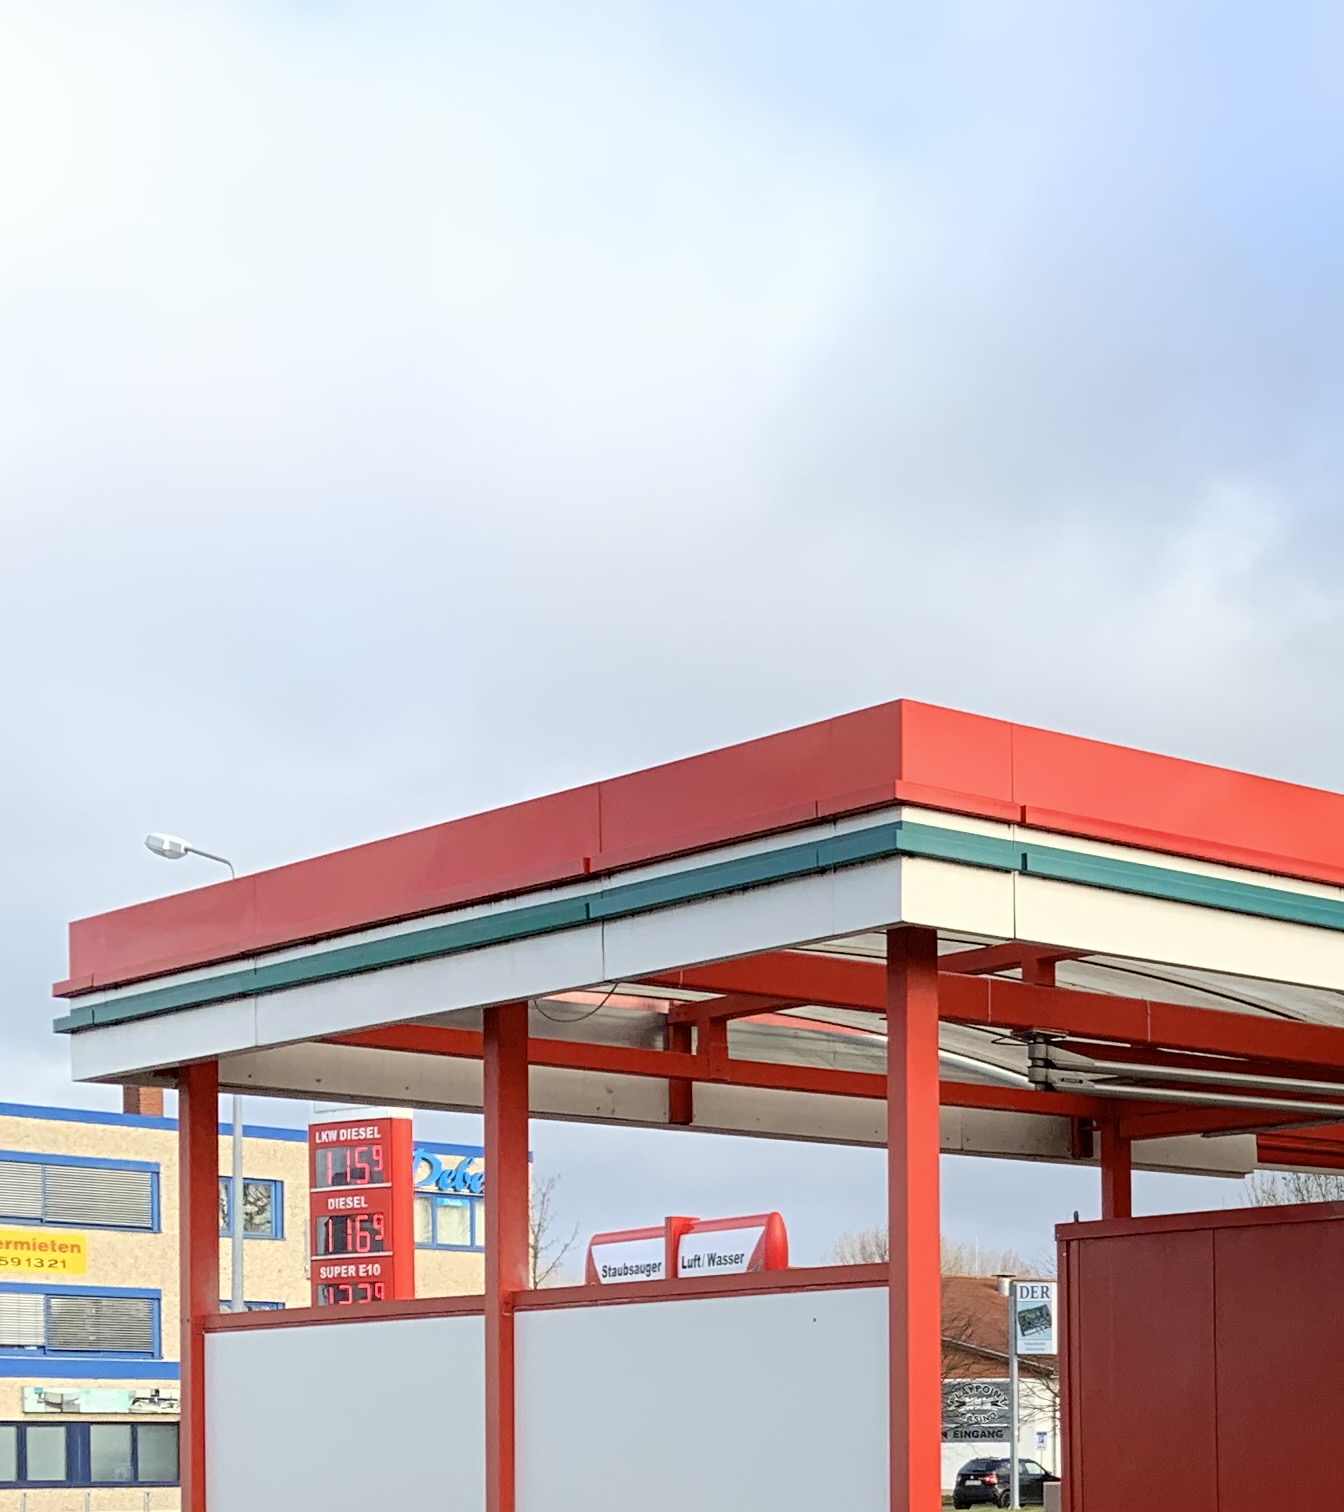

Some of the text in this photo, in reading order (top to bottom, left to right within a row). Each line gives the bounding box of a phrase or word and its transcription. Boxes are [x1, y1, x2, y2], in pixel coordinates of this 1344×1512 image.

[315, 1126, 382, 1143] LKW DIESEL
[327, 1196, 368, 1210] DIESEL
[319, 1263, 381, 1279] SUPER E10
[601, 1261, 662, 1278] Staubsauger
[1019, 1285, 1050, 1299] DER
[953, 1430, 1004, 1439] EINGANG
